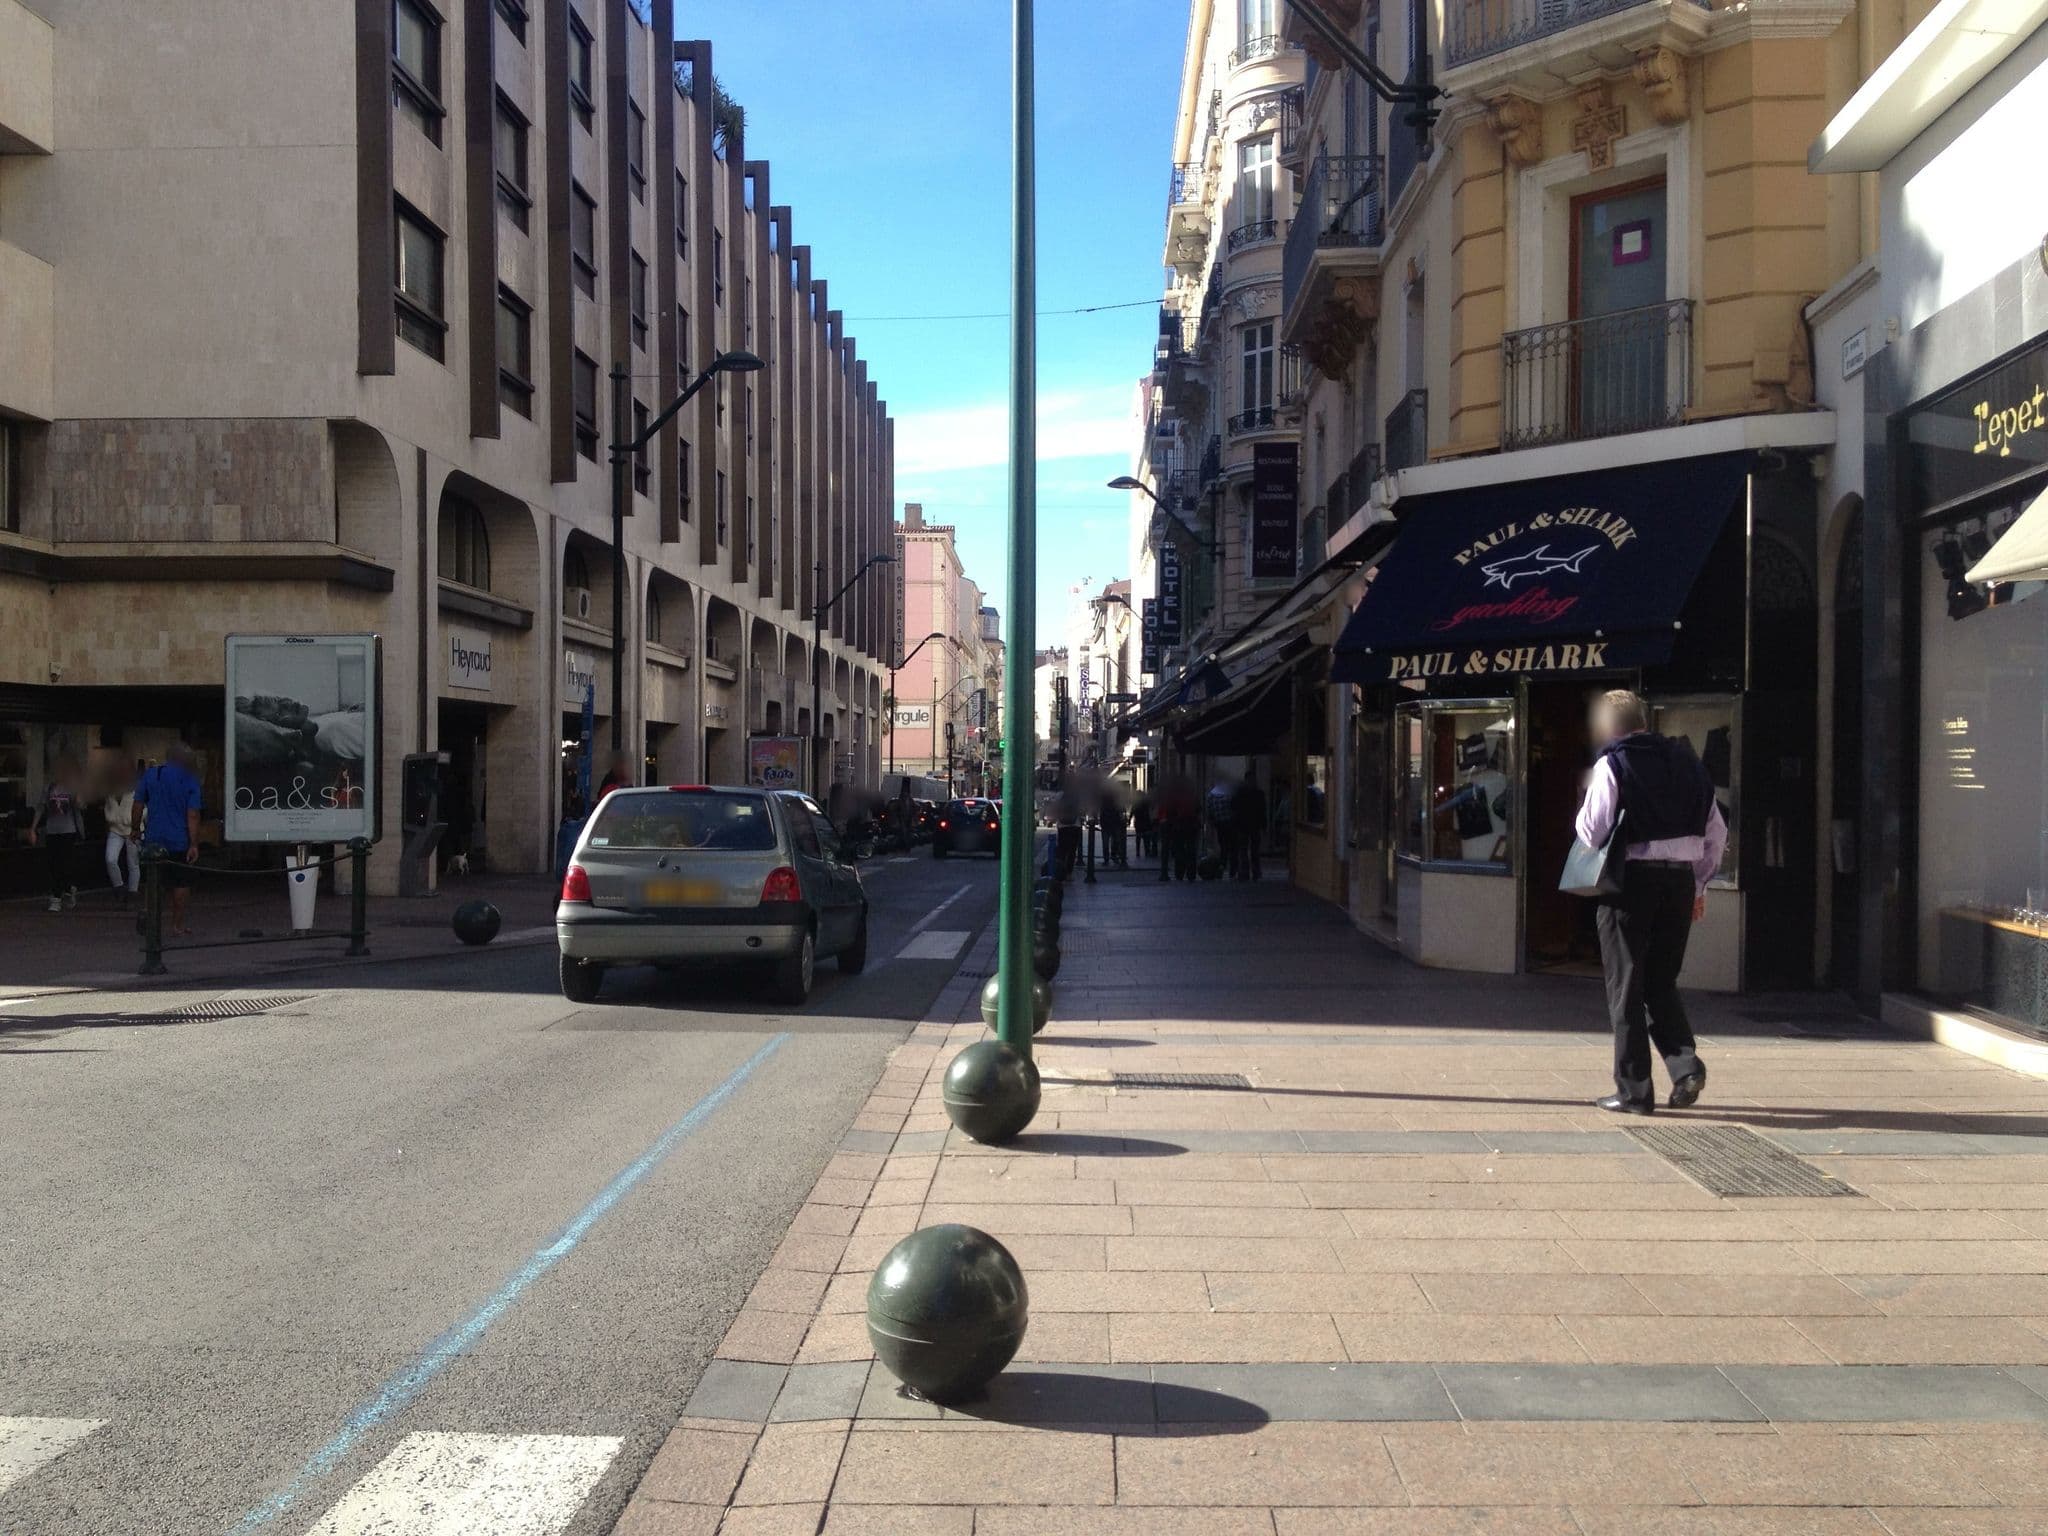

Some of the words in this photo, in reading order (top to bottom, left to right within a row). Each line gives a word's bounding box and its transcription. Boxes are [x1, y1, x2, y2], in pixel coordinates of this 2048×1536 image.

[1973, 383, 2048, 457] repet
[1453, 522, 1523, 566] PAUL
[1529, 511, 1554, 530] &
[1556, 507, 1638, 550] SHARK
[1163, 552, 1179, 625] HOTEL
[451, 637, 491, 678] Heyraud
[1144, 601, 1158, 671] HOTEL
[1388, 652, 1457, 679] PAUL
[1464, 650, 1488, 674] &
[1492, 643, 1609, 672] SHARK
